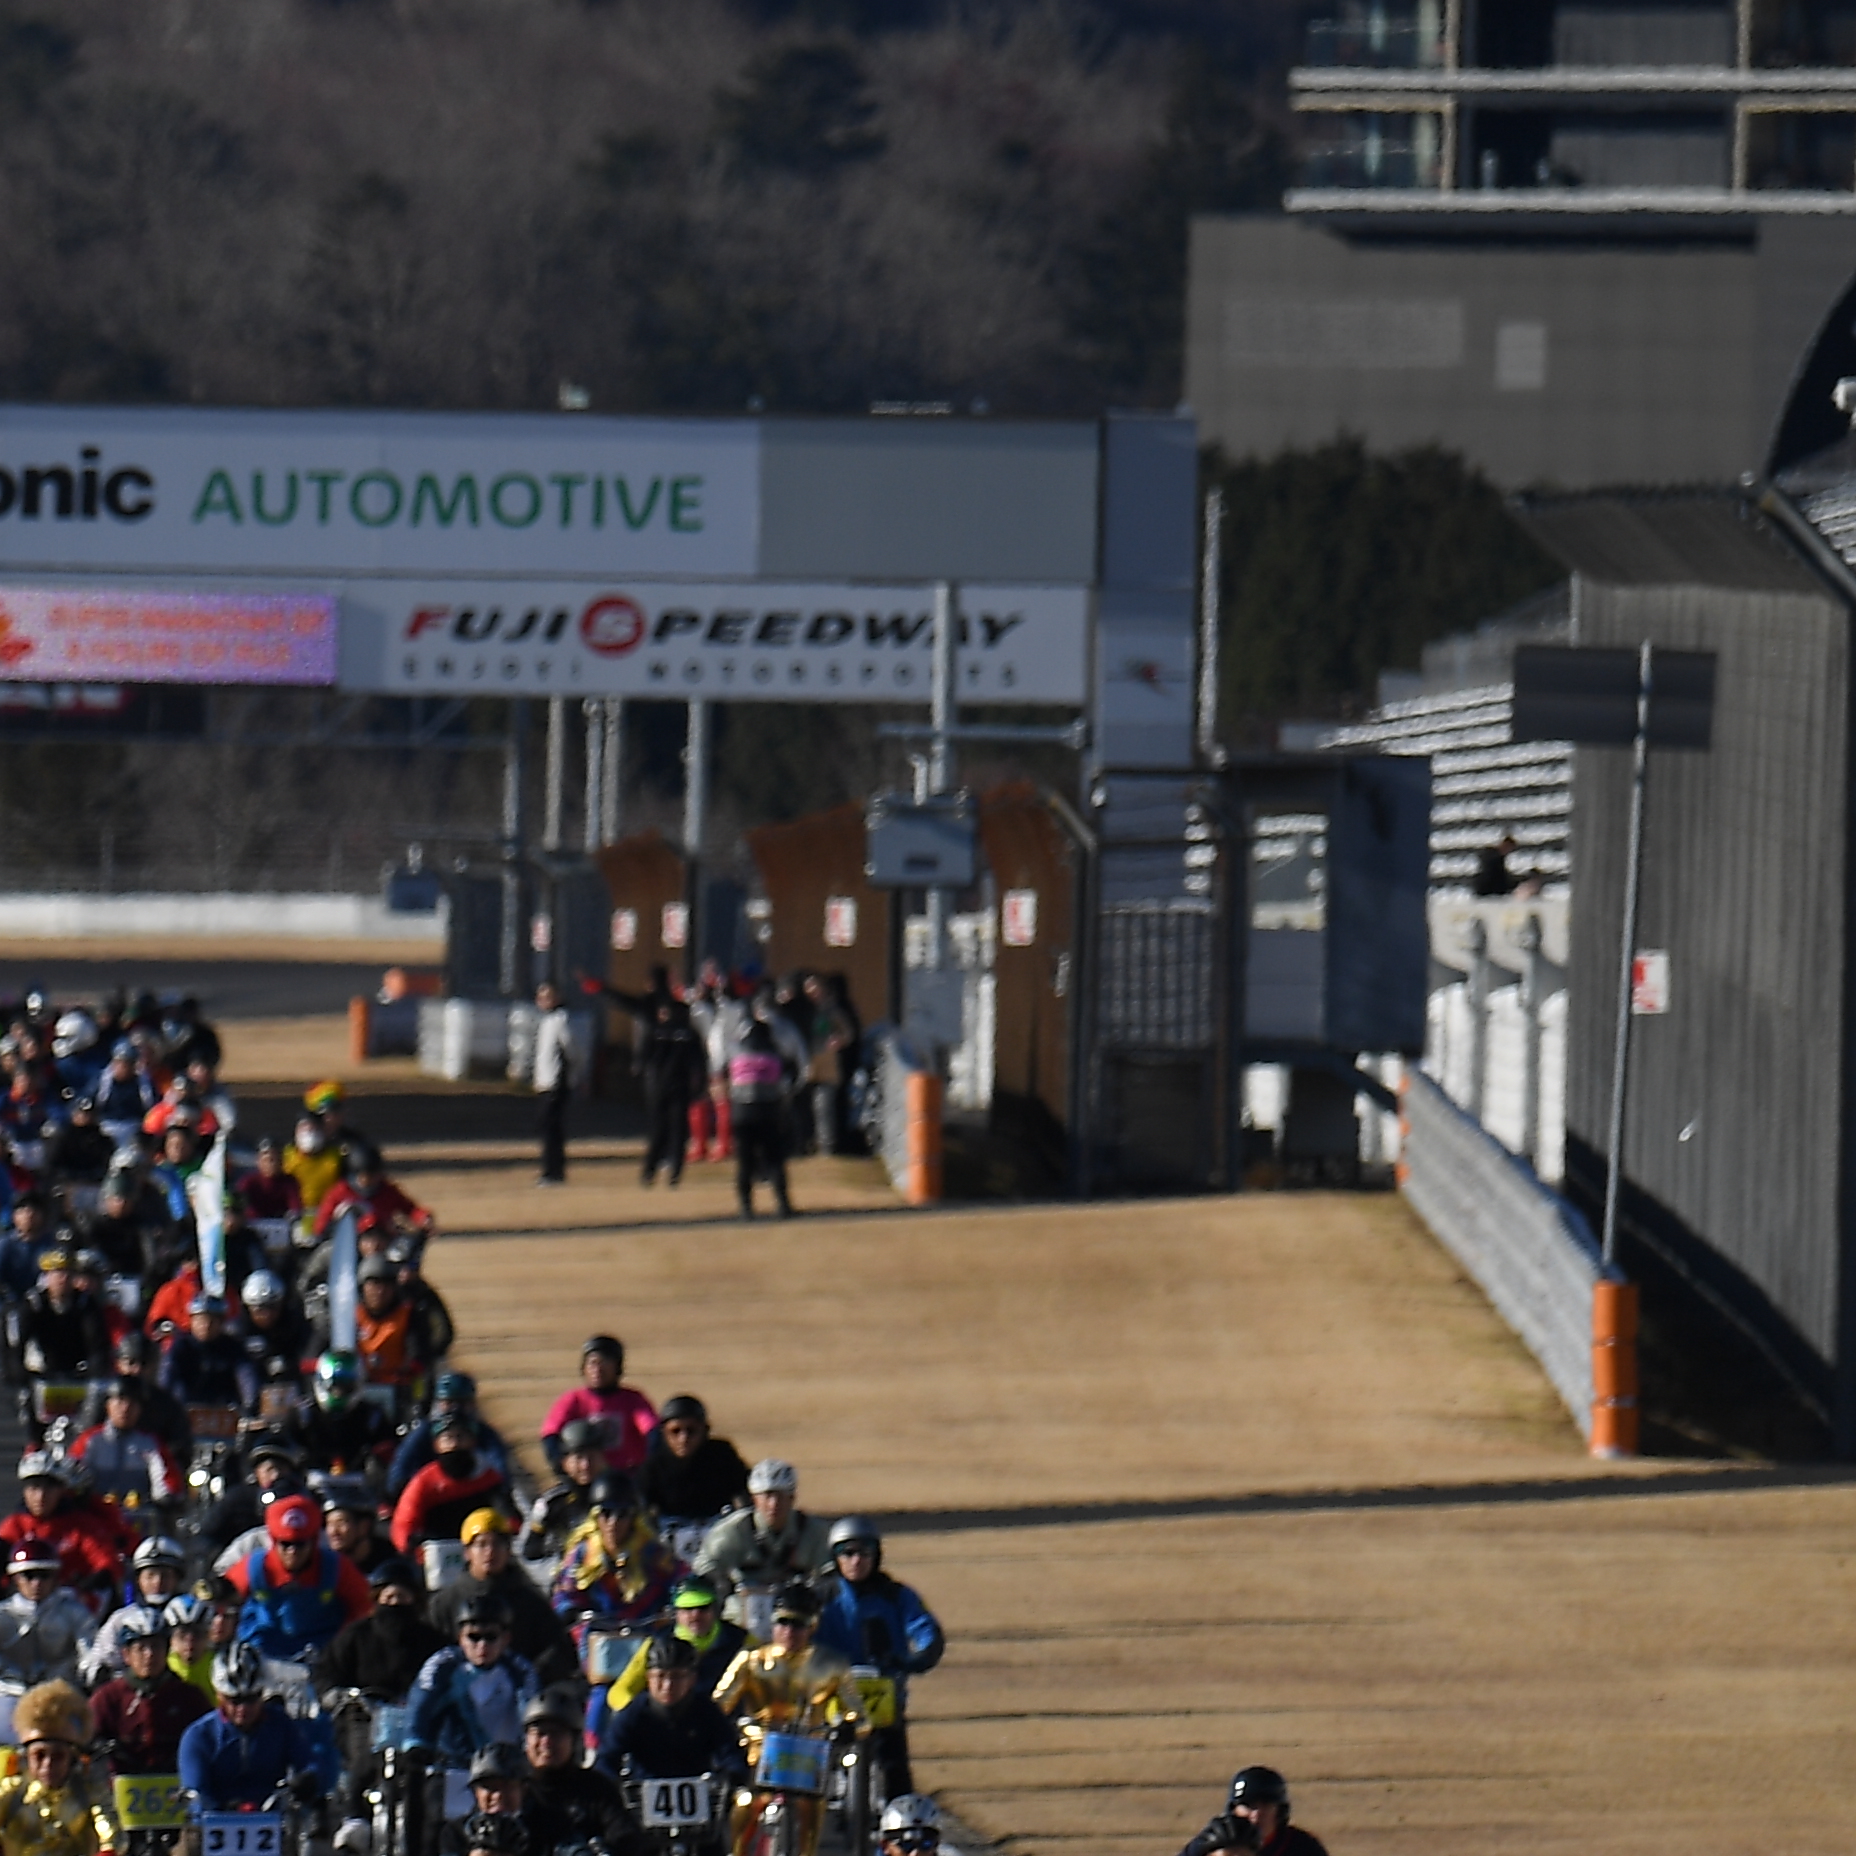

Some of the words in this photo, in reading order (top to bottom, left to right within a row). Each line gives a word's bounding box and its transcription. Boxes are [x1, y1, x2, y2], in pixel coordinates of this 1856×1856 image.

[191, 466, 706, 534] AUTOMOTIVE
[403, 606, 568, 645] FUJI
[647, 657, 1018, 690] MOTORSPOTS
[653, 1781, 697, 1819] 40
[208, 1828, 274, 1853] 312
